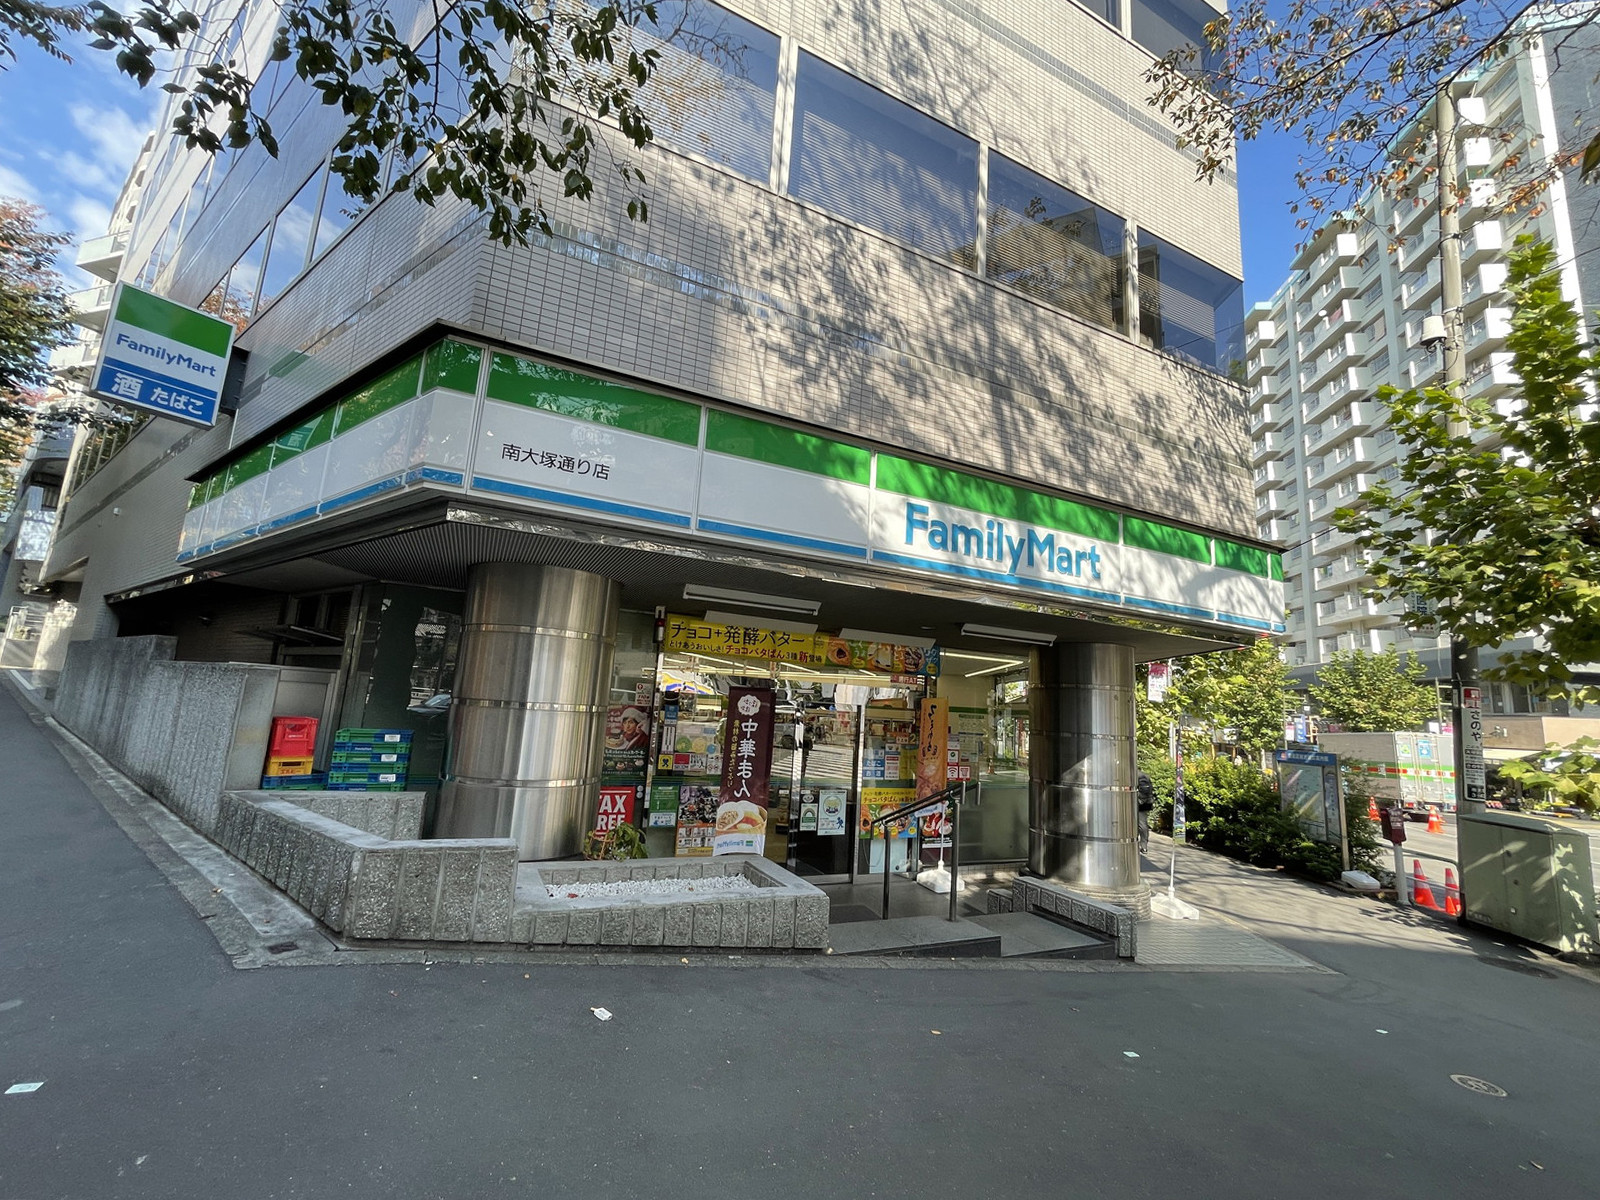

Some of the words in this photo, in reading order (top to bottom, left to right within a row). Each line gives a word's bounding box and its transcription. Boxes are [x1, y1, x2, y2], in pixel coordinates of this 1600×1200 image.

[116, 333, 217, 377] FamilyMart
[111, 372, 144, 400] 酒
[150, 386, 204, 416] たばこ
[501, 443, 611, 481] 南大塚通り店
[904, 501, 1101, 580] FamilyMart
[1470, 710, 1482, 742] さのや
